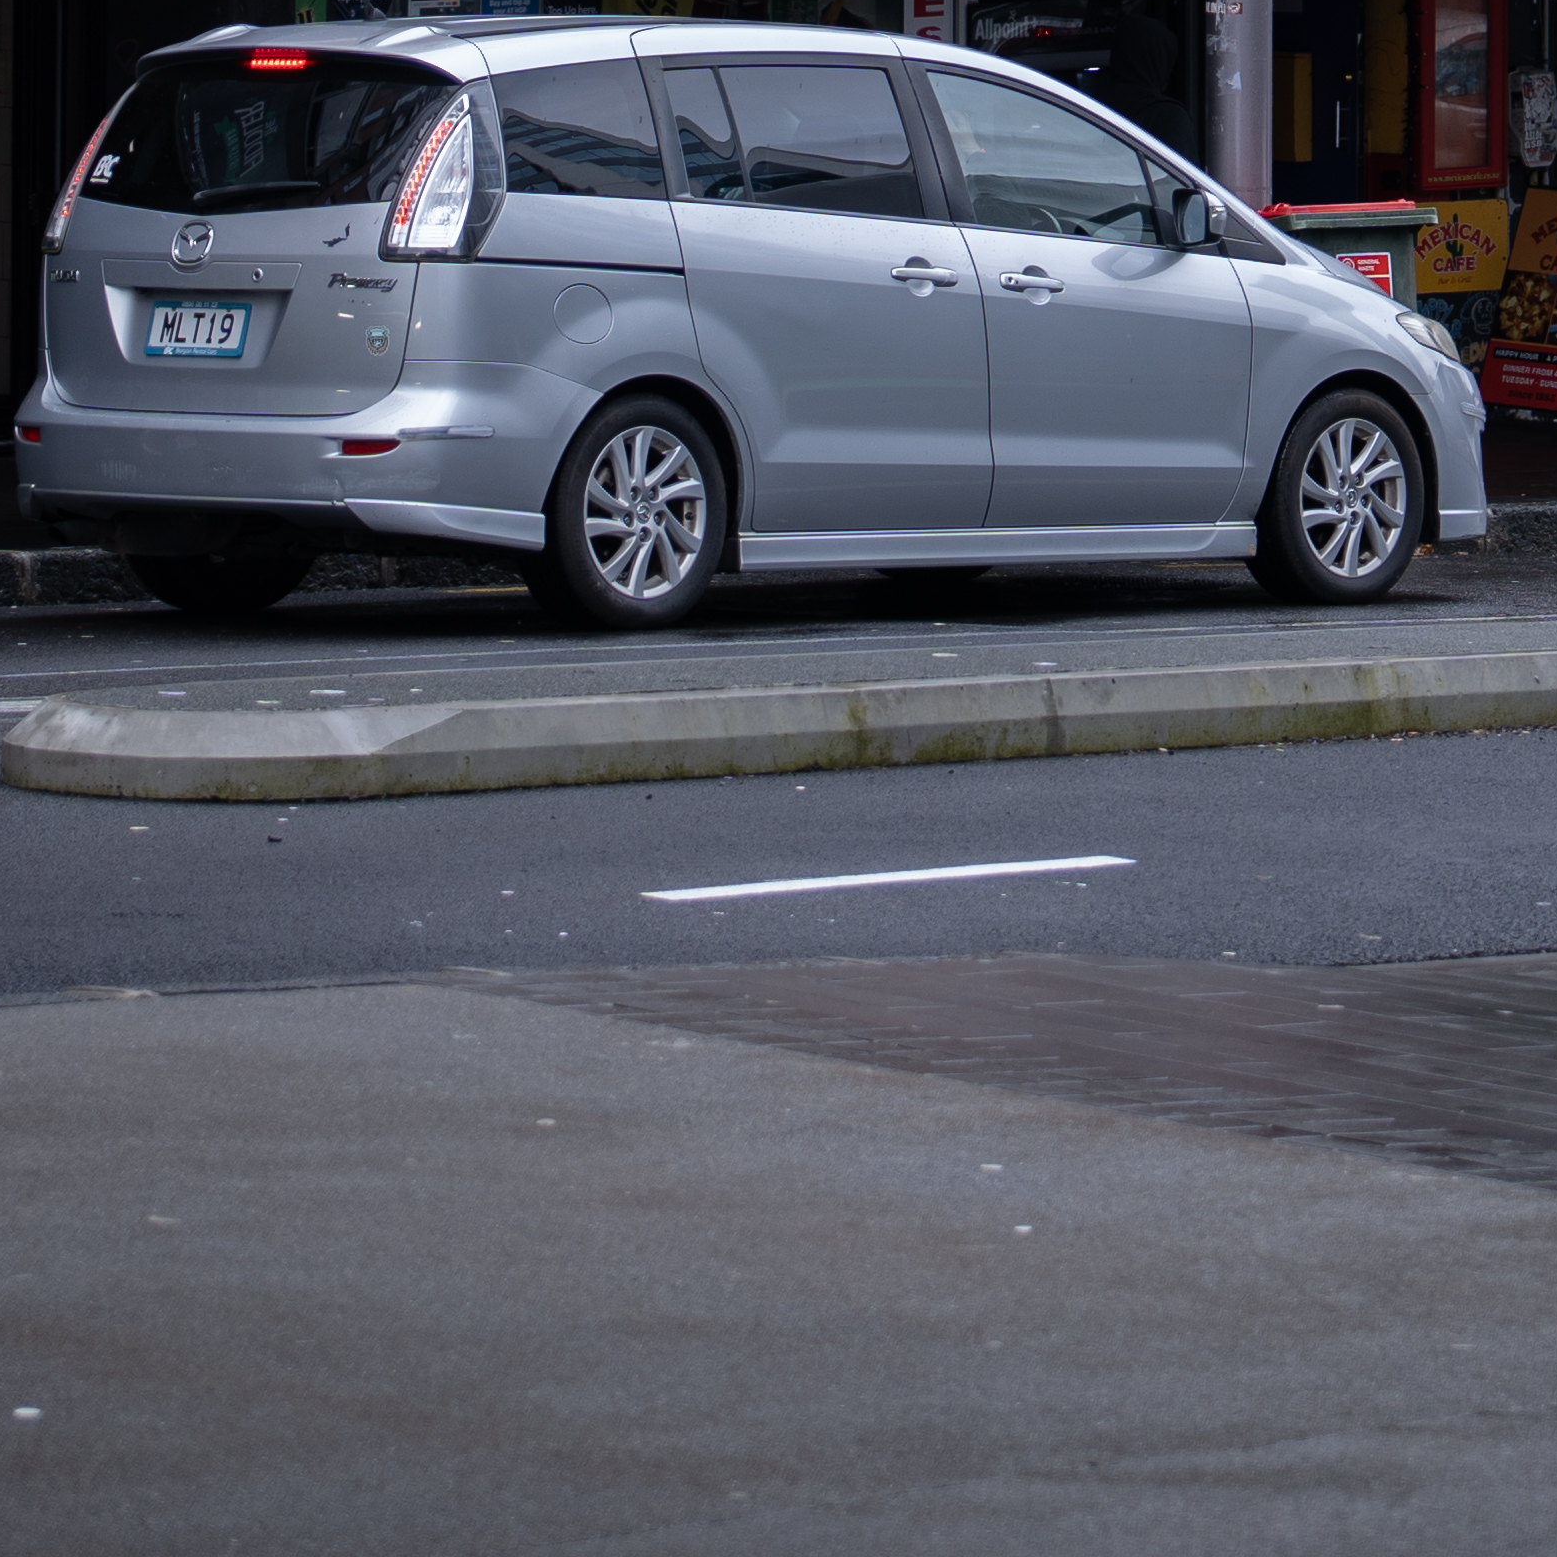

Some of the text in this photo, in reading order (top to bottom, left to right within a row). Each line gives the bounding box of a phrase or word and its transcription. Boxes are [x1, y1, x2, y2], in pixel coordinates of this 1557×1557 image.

[973, 17, 1032, 43] Allpoint
[1414, 223, 1498, 261] MEXICAN
[158, 310, 238, 346] MLT19
